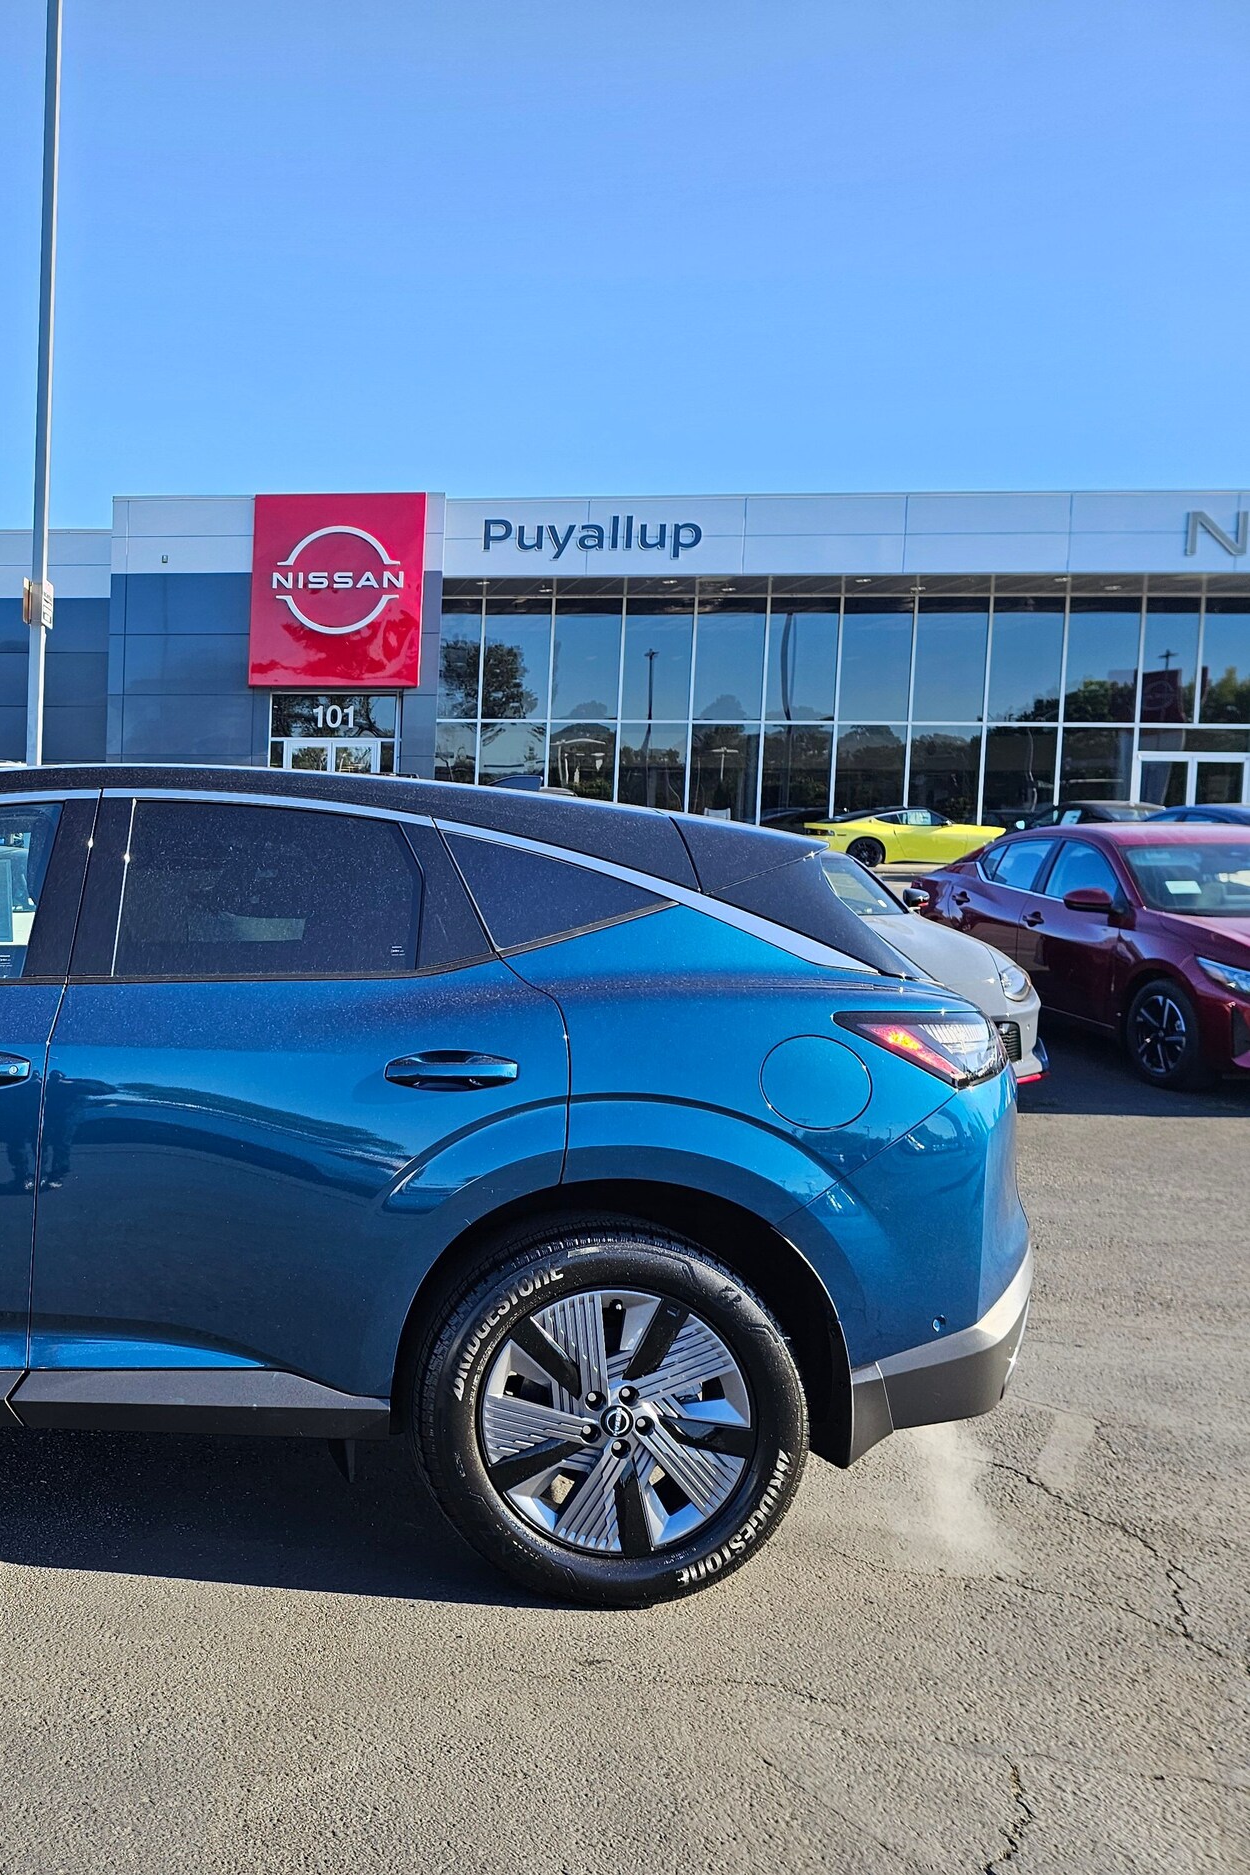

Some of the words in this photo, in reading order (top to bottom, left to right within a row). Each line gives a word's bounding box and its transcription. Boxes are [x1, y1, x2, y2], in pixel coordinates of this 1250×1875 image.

[482, 515, 703, 561] Puyallup
[1184, 511, 1249, 556] N
[272, 571, 404, 589] NISSAN
[313, 704, 354, 728] 101
[453, 1265, 565, 1402] BRIDGESTONE
[675, 1449, 794, 1589] BRIDGESTONE
